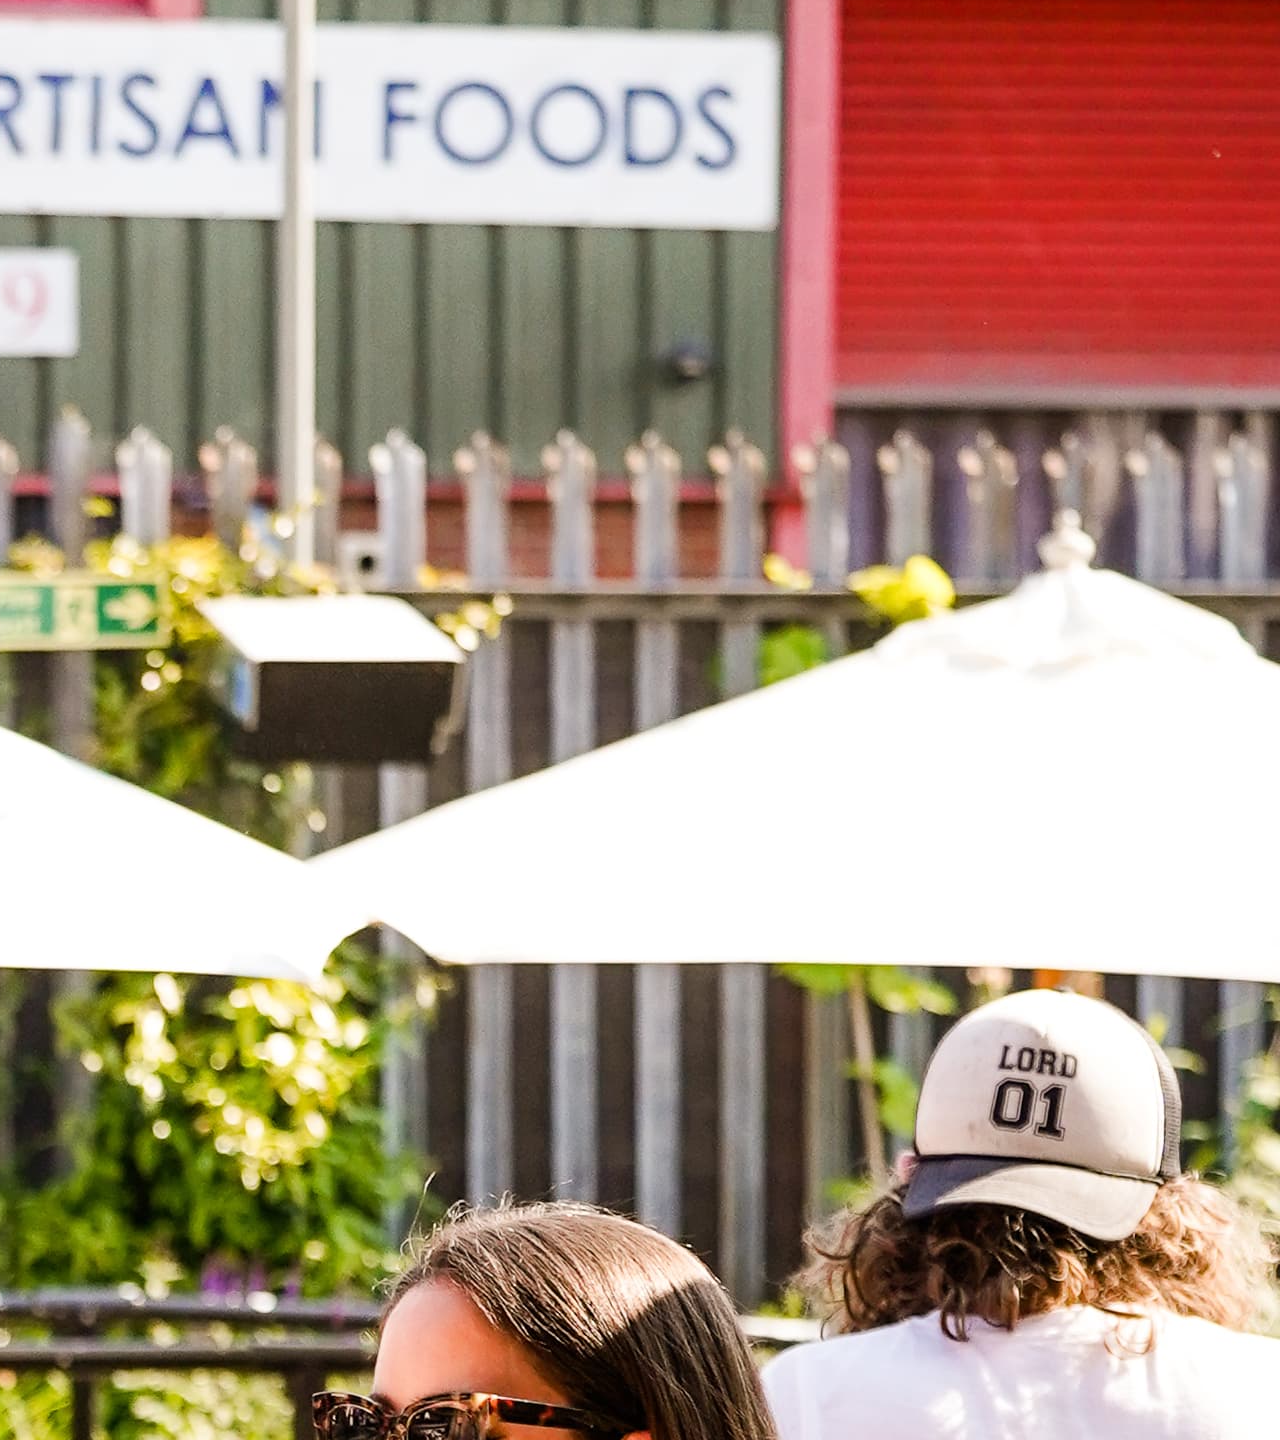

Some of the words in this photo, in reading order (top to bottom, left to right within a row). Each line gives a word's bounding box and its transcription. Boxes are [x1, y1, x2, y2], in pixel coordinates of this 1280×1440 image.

[384, 80, 738, 171] FOODS
[0, 269, 49, 338] 9
[998, 1045, 1079, 1079] LORD
[989, 1077, 1070, 1142] 01
